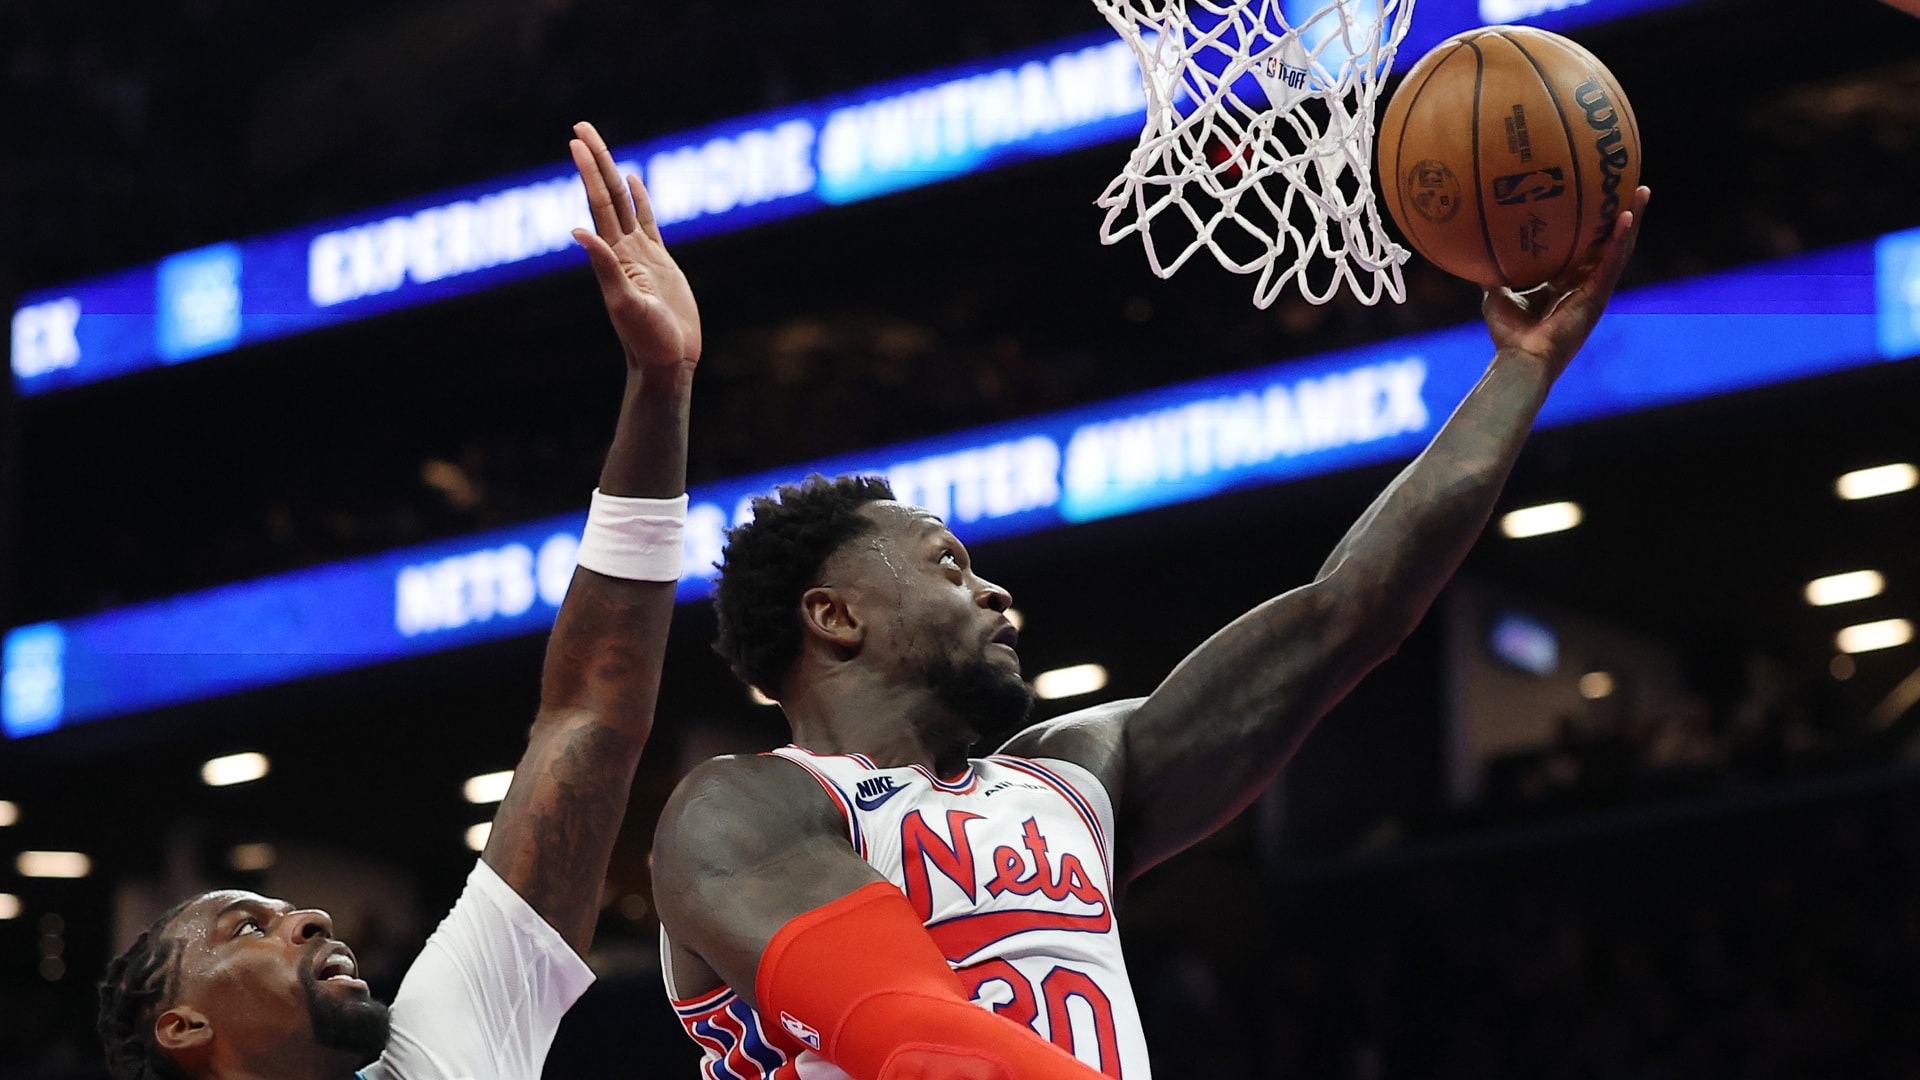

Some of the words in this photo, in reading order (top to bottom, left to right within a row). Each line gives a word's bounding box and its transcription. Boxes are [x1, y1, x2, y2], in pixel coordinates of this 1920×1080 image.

[308, 161, 643, 308] EXPERIEN
[646, 118, 816, 228] MORE
[395, 542, 537, 638] NETS
[856, 776, 894, 798] NIKE
[900, 809, 1105, 925] Nets
[953, 957, 1122, 1080] 30
